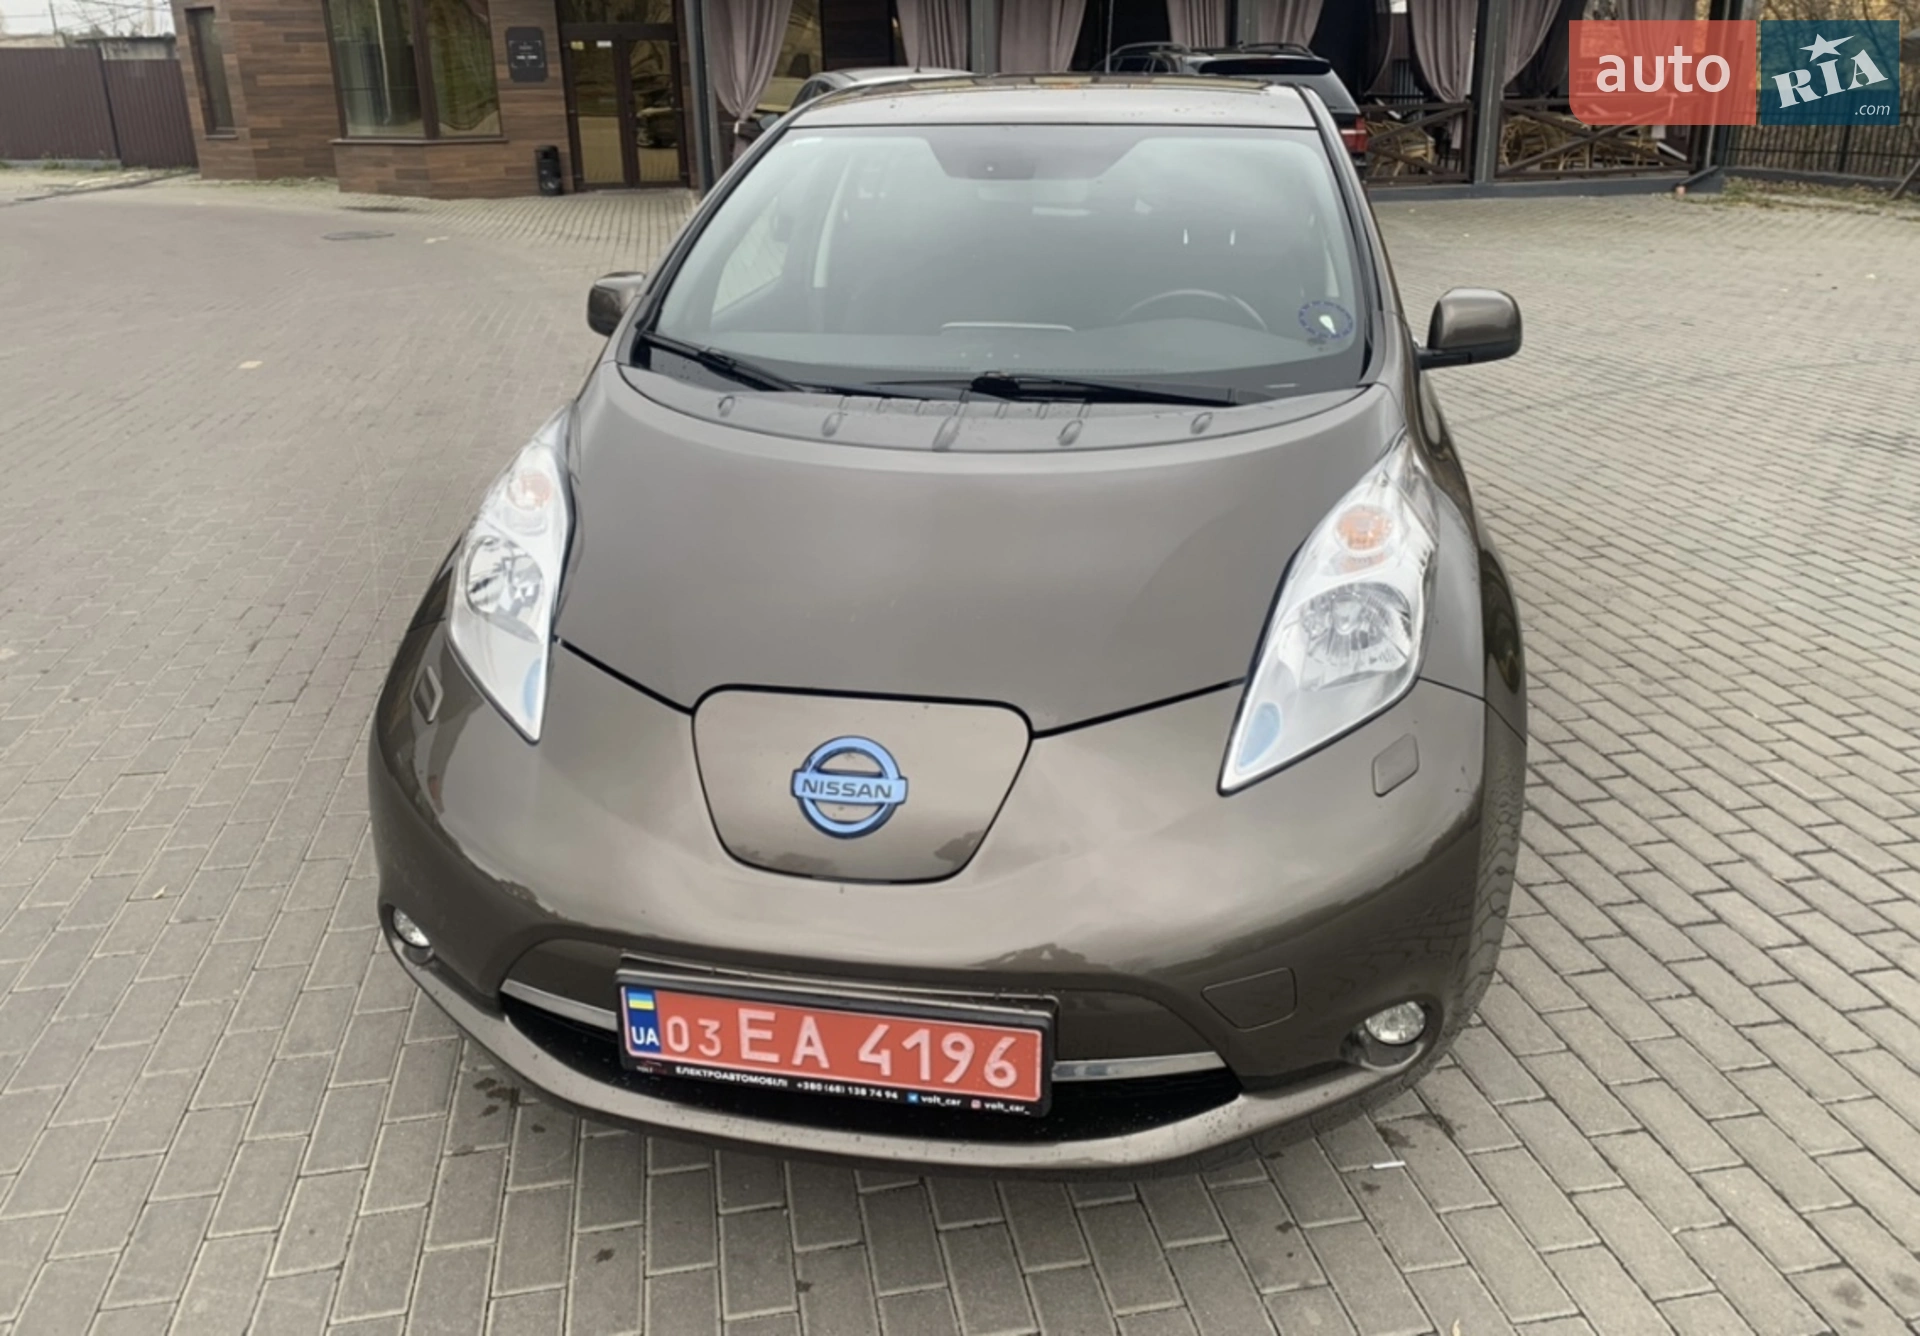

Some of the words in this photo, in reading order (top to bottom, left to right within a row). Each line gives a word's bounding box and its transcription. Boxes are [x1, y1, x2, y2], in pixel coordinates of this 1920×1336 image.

[802, 778, 892, 799] NISSAN
[631, 1025, 660, 1047] UA
[666, 1015, 722, 1058] 03
[738, 1007, 830, 1069] EA
[858, 1022, 1019, 1089] 4196
